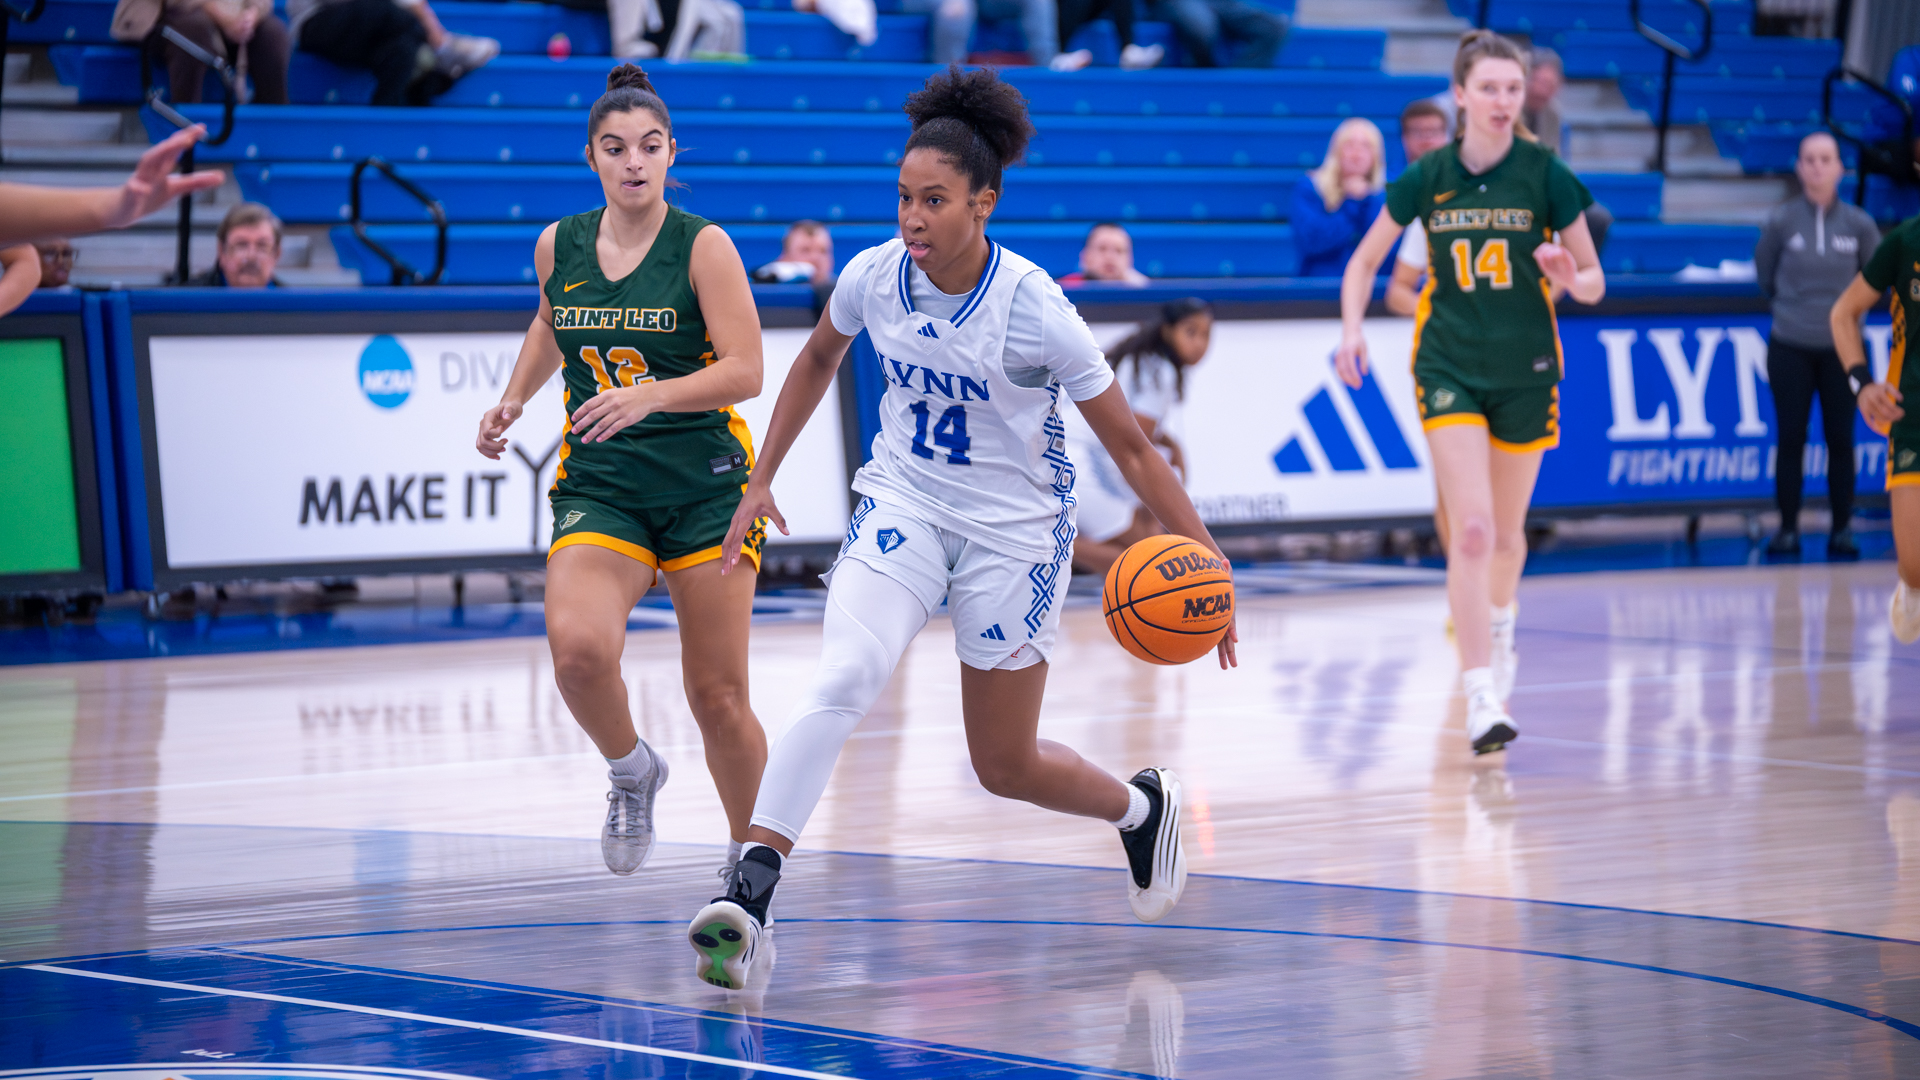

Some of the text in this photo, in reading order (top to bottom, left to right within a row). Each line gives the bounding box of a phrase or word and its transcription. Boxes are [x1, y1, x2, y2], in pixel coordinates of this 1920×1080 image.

[1450, 238, 1513, 292] 14
[553, 306, 677, 332] SAINT LEO
[363, 368, 414, 395] NCAA
[579, 345, 656, 395] 12
[877, 350, 990, 402] LYNN
[1597, 325, 1894, 441] LYN
[909, 400, 972, 466] 14
[1608, 445, 1760, 485] FIGHTING
[299, 474, 446, 526] MAKE
[463, 472, 507, 519] IT
[1155, 552, 1229, 581] Wilson
[1182, 592, 1231, 618] NCAA
